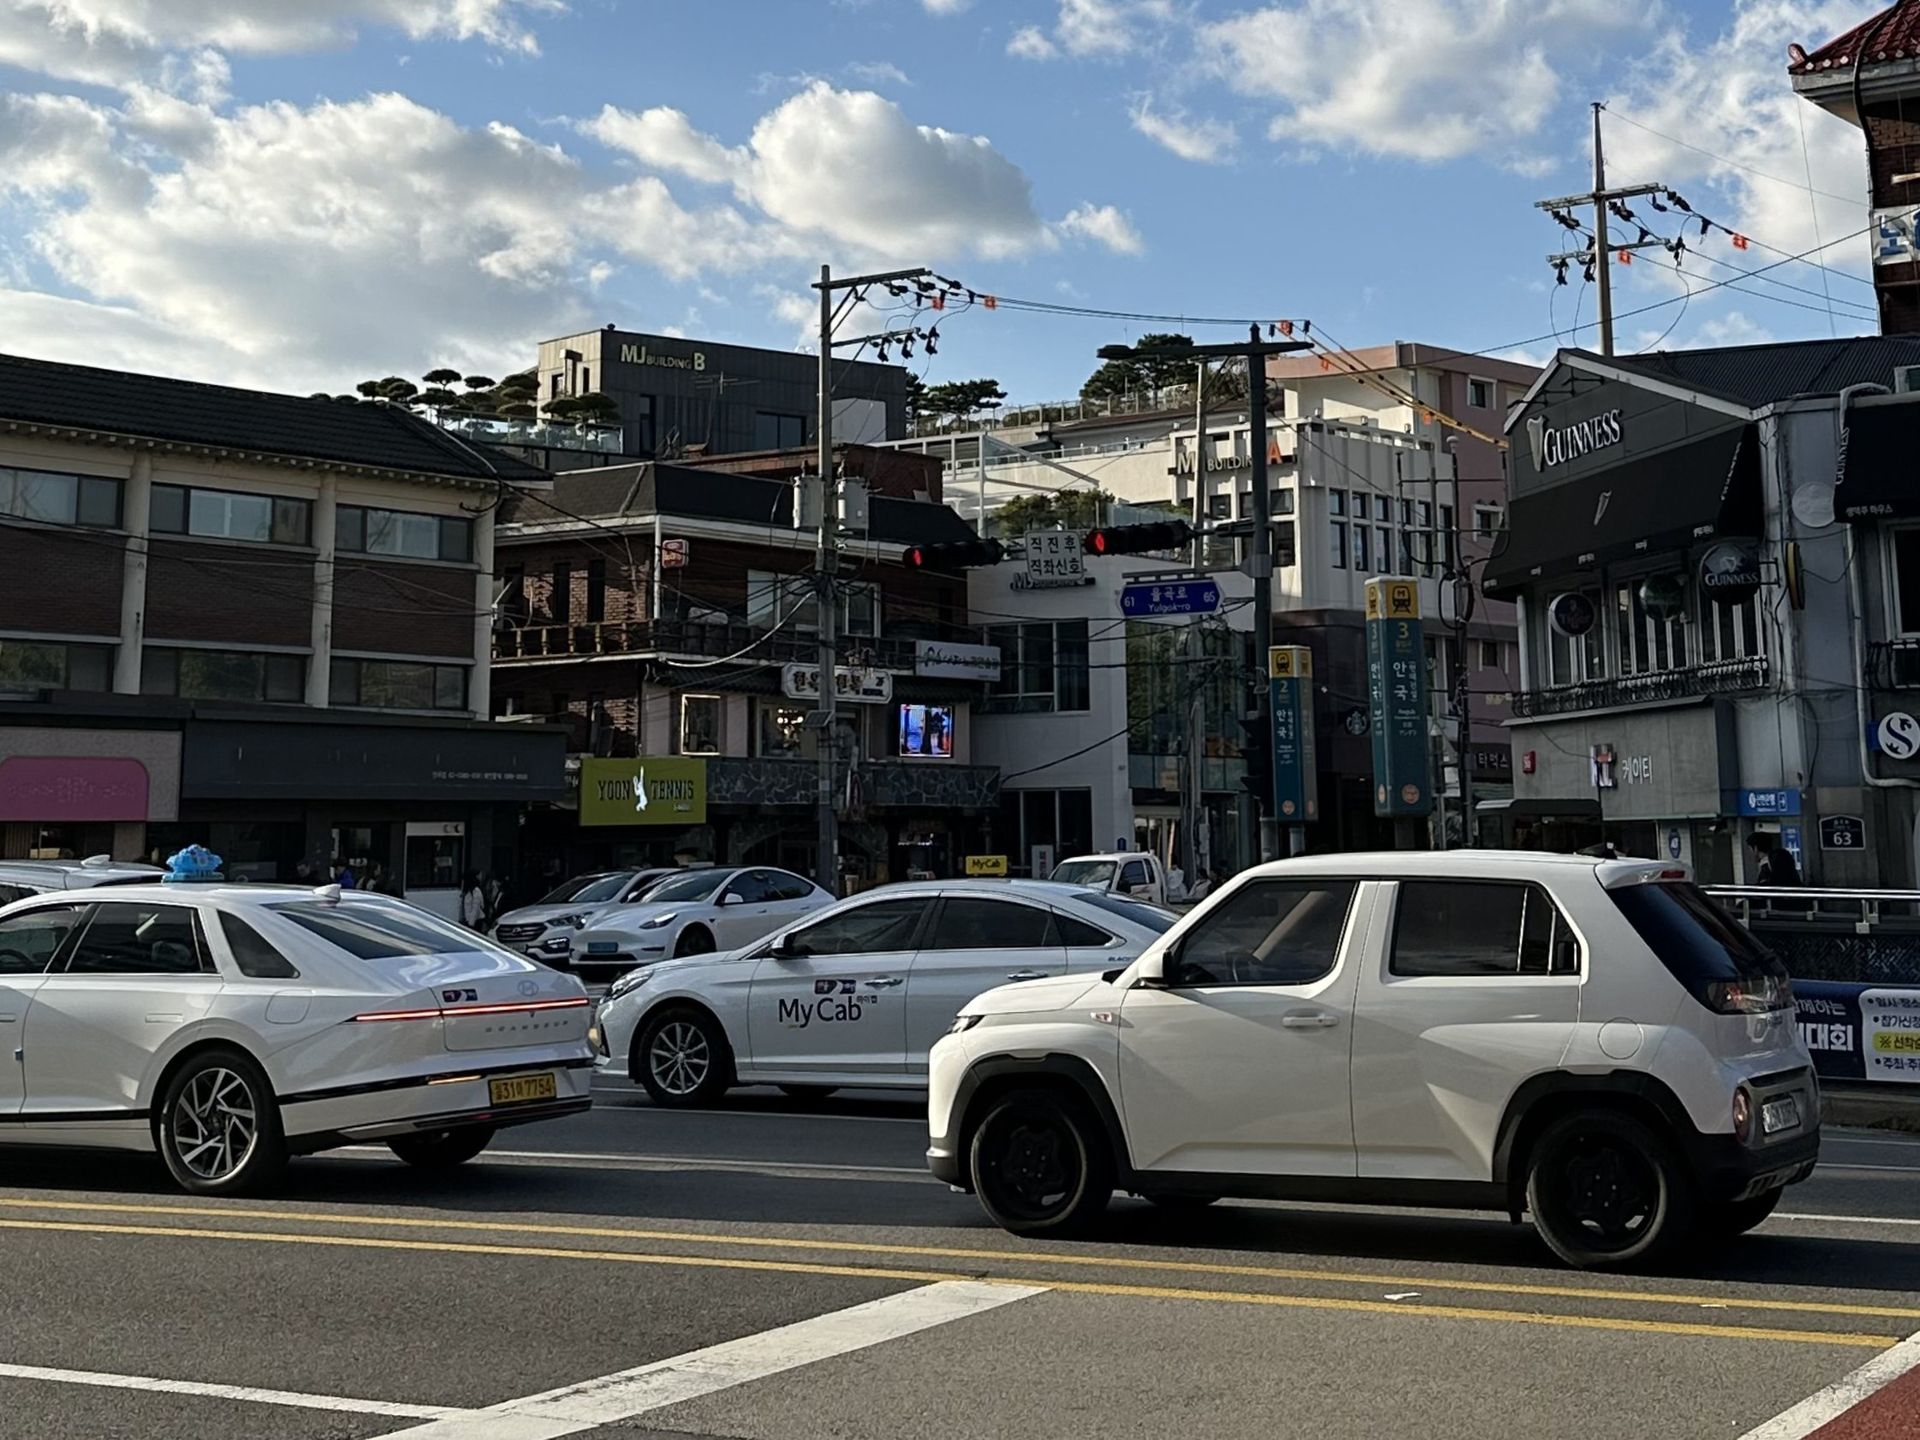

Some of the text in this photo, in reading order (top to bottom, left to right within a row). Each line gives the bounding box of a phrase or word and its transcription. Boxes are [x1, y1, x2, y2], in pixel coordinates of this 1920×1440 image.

[621, 344, 706, 371] MJ BUILDING B
[1544, 408, 1622, 466] GUINNESS
[1266, 441, 1283, 465] A
[1031, 558, 1081, 576] 직좌신호
[1704, 572, 1760, 588] GUINNESS
[1123, 596, 1135, 608] 61
[1150, 586, 1189, 602] 율곡로
[1203, 591, 1216, 603] 65
[1148, 602, 1191, 614] Yulgok-ro
[1399, 622, 1409, 639] 3
[1280, 681, 1289, 694] 2
[1392, 660, 1409, 702] 안국
[1276, 709, 1287, 740] 안국
[1622, 756, 1653, 785] 케이티
[598, 780, 694, 801] YOON TENNIS
[1833, 832, 1852, 846] 63
[972, 859, 1000, 871] MyCab
[1795, 999, 1847, 1016] 께하는
[1797, 1022, 1854, 1051] 대회
